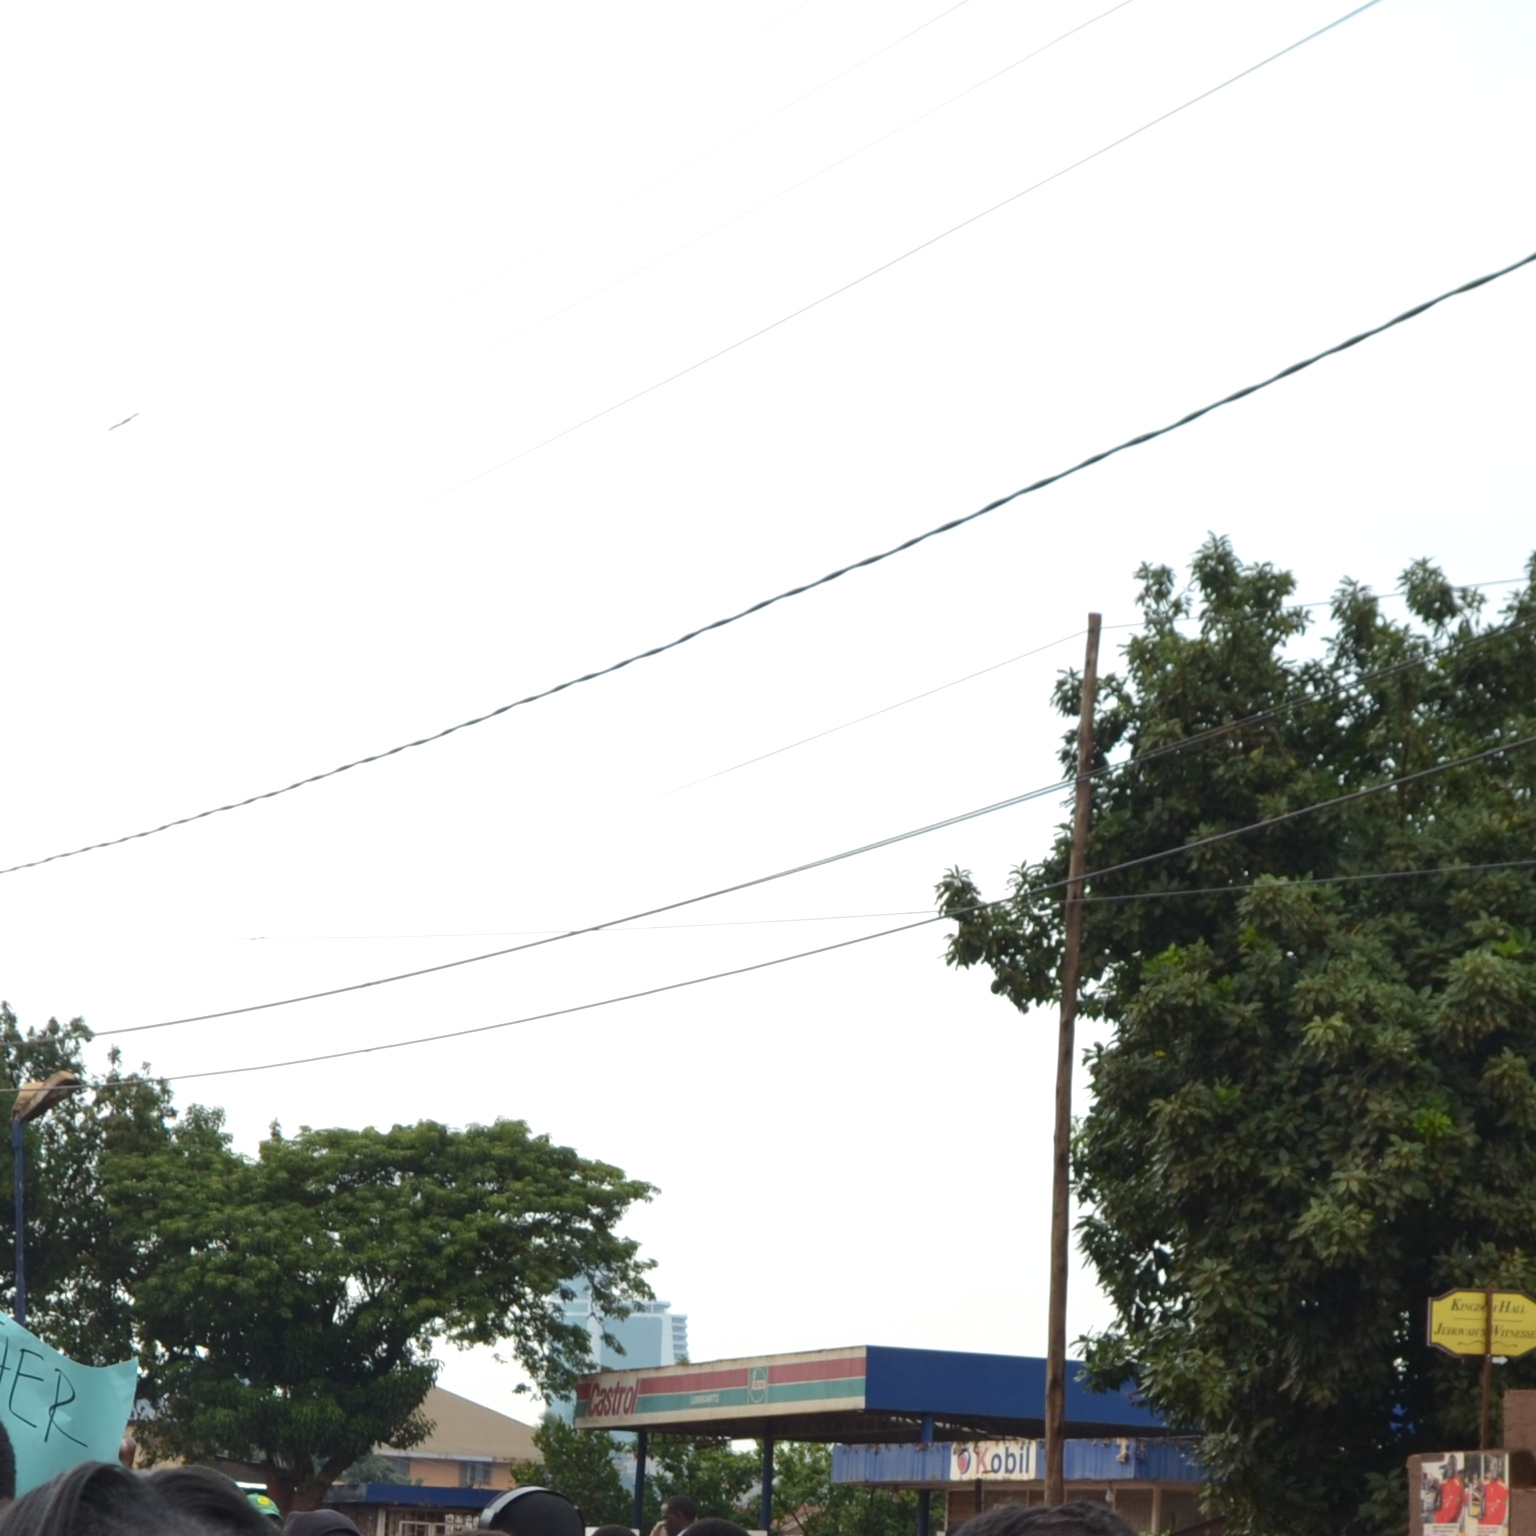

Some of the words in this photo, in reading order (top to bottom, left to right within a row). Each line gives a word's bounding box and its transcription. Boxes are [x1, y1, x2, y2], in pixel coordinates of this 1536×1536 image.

[1451, 1298, 1498, 1313] KINGDM
[586, 1379, 639, 1417] Castrol
[976, 1445, 1030, 1475] Kobil
